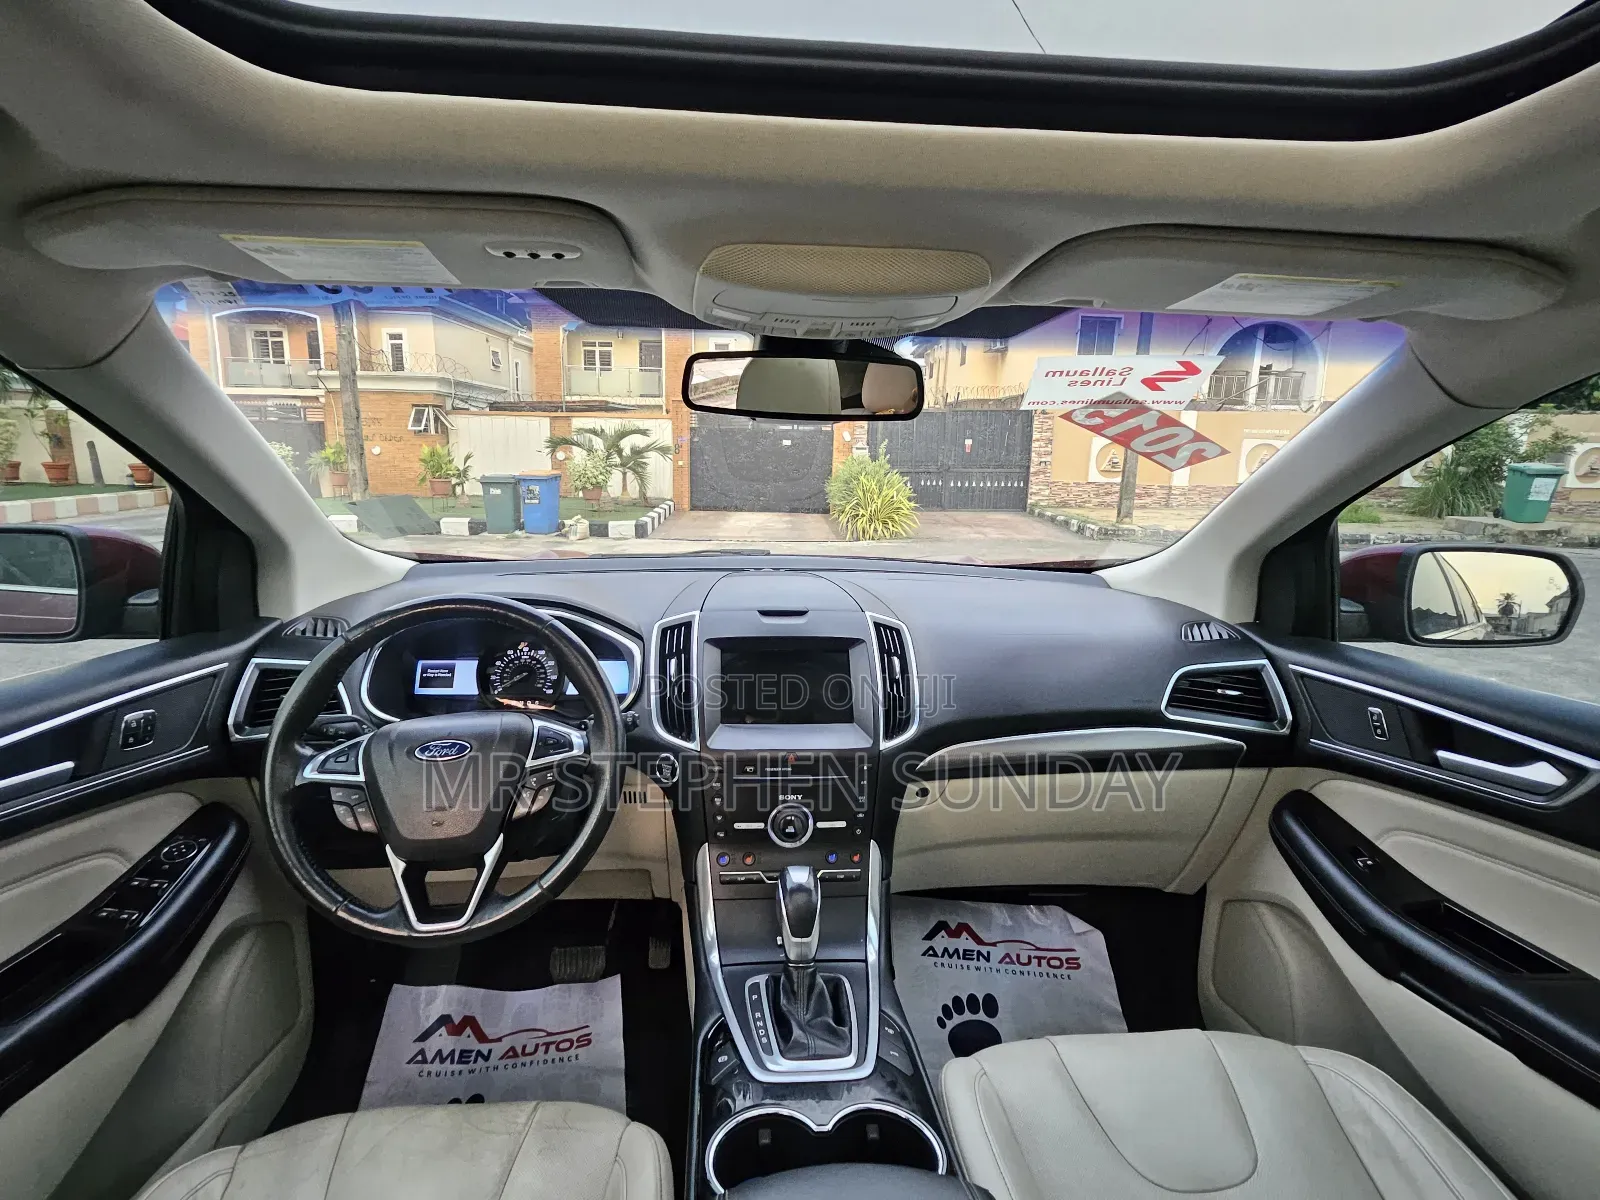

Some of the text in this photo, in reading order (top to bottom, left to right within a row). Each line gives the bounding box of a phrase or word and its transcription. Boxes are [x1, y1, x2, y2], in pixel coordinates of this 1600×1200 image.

[920, 945, 1082, 971] AMEN AUTOS
[933, 961, 1072, 981] CRUISE WITH CONFIDENCE
[405, 1031, 593, 1065] AMEN AUTOS
[418, 1053, 580, 1078] CRUISE WITH CONFIDENCE
